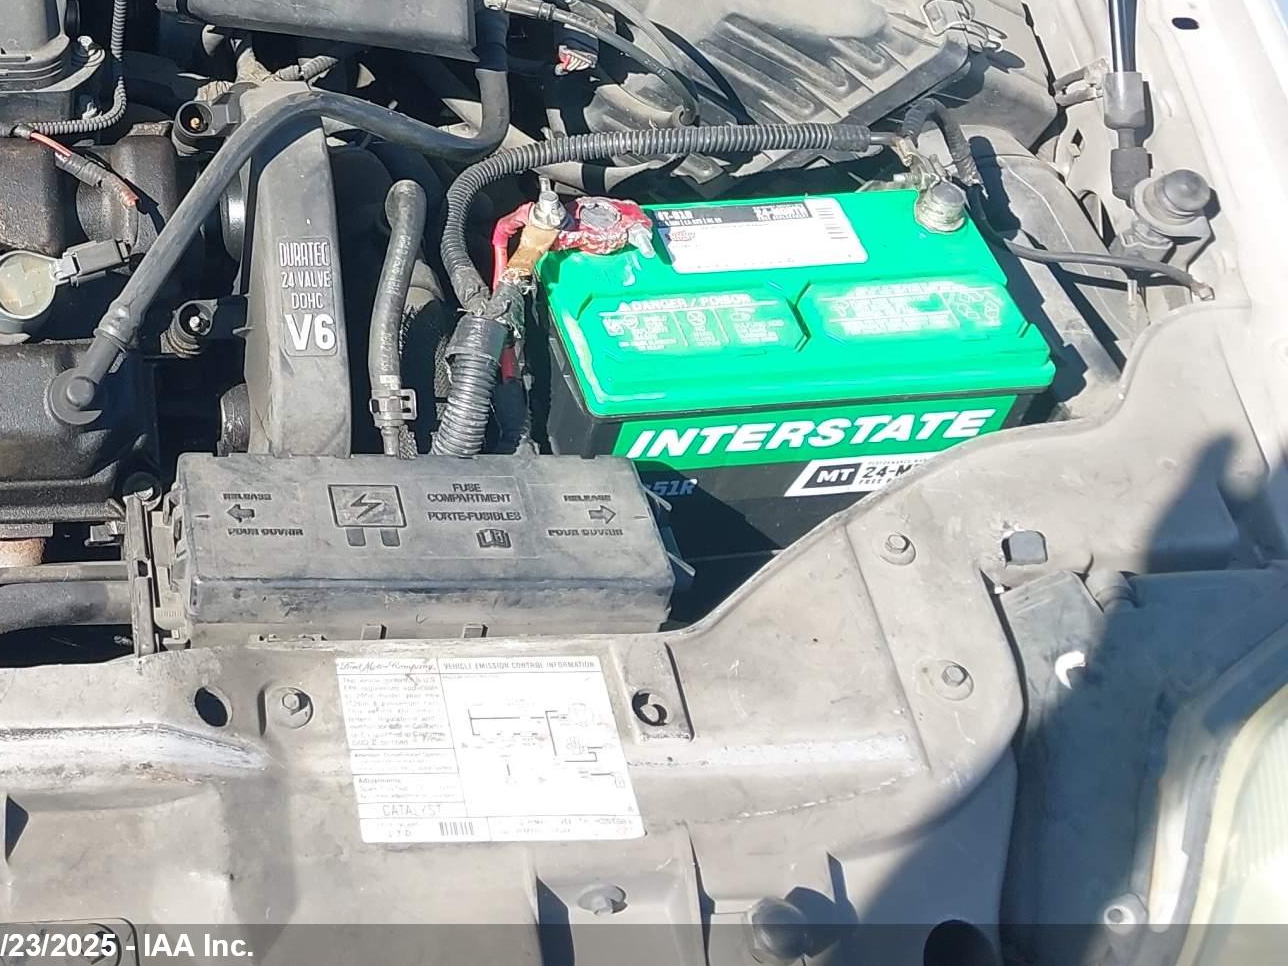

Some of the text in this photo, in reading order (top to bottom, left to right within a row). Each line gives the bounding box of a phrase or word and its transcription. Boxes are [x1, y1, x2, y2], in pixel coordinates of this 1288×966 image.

[279, 241, 331, 267] DURATEC
[281, 270, 332, 288] 24 VALVE
[291, 292, 324, 309] DOHC
[630, 297, 688, 311] DANGER
[284, 313, 336, 351] V6
[626, 408, 996, 459] INTERSTATE
[815, 463, 921, 484] MT 24-M
[452, 483, 482, 493] FUSE
[427, 493, 512, 503] COMPARTMENT
[427, 511, 522, 521] PORTE-FUSIBLES
[228, 527, 259, 536] POUR
[443, 661, 595, 670] VEHICLE EMISSION CONTROL INFORMATION
